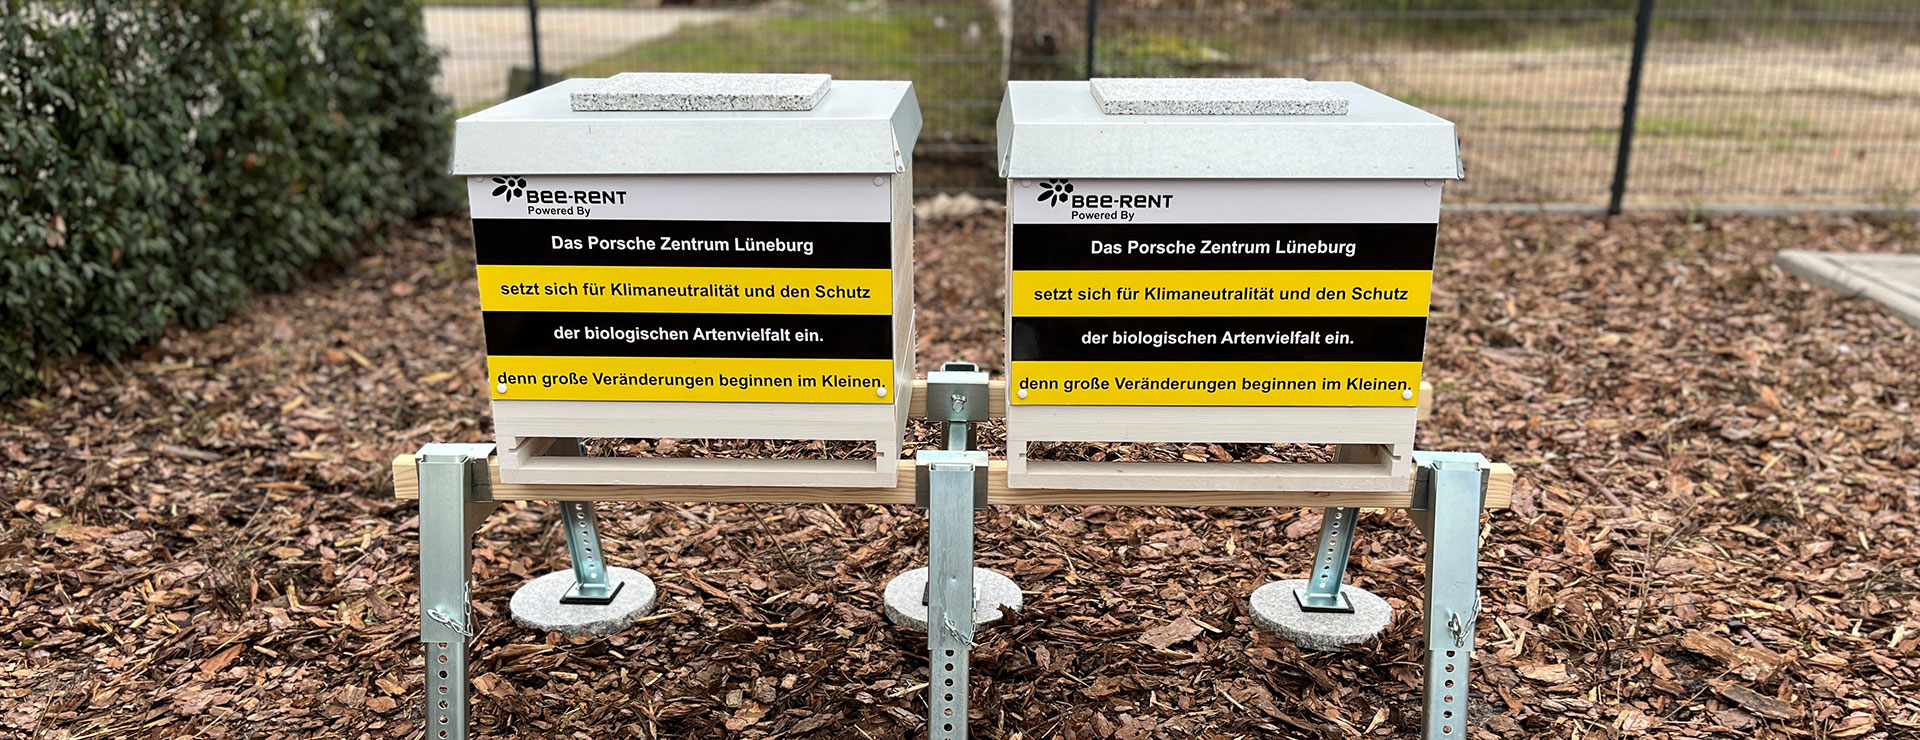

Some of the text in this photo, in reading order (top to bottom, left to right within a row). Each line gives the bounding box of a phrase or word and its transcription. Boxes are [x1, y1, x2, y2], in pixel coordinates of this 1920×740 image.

[528, 206, 590, 218] Powered By
[1072, 211, 1134, 222] Powered By
[552, 236, 813, 256] Das Porsche Zentrum Lüneburg
[1092, 240, 1356, 258] Das Porsche Zentrum Lüneburg
[501, 283, 870, 299] setzt sich für Klimaneutralität und den Schutz
[1034, 287, 1408, 301] setzt sich für Klimaneutralität und den Schutz
[554, 326, 823, 344] der biologischen Artenvielfalt ein.
[1082, 331, 1353, 348] der biologischen Artenvielfalt ein.
[498, 372, 885, 390] denn große Veränderungen beginnen im Kleinen.
[1020, 377, 1411, 394] denn große Veränderungen beginnen im Kleinen.
